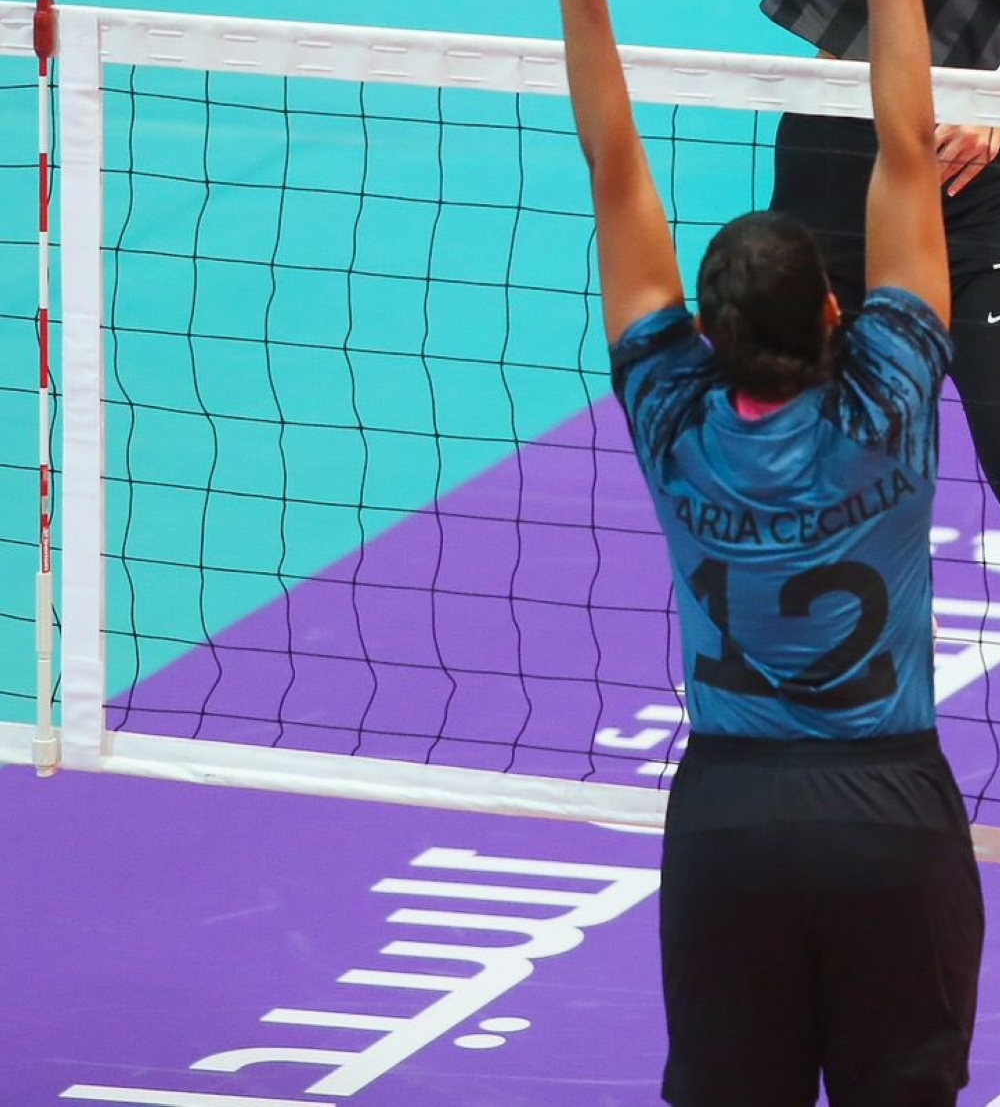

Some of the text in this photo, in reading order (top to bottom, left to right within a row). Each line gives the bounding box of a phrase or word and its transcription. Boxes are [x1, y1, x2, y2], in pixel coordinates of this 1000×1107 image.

[769, 468, 916, 543] CECILIA
[689, 559, 897, 710] 12
[59, 847, 664, 1107] للسيدا
